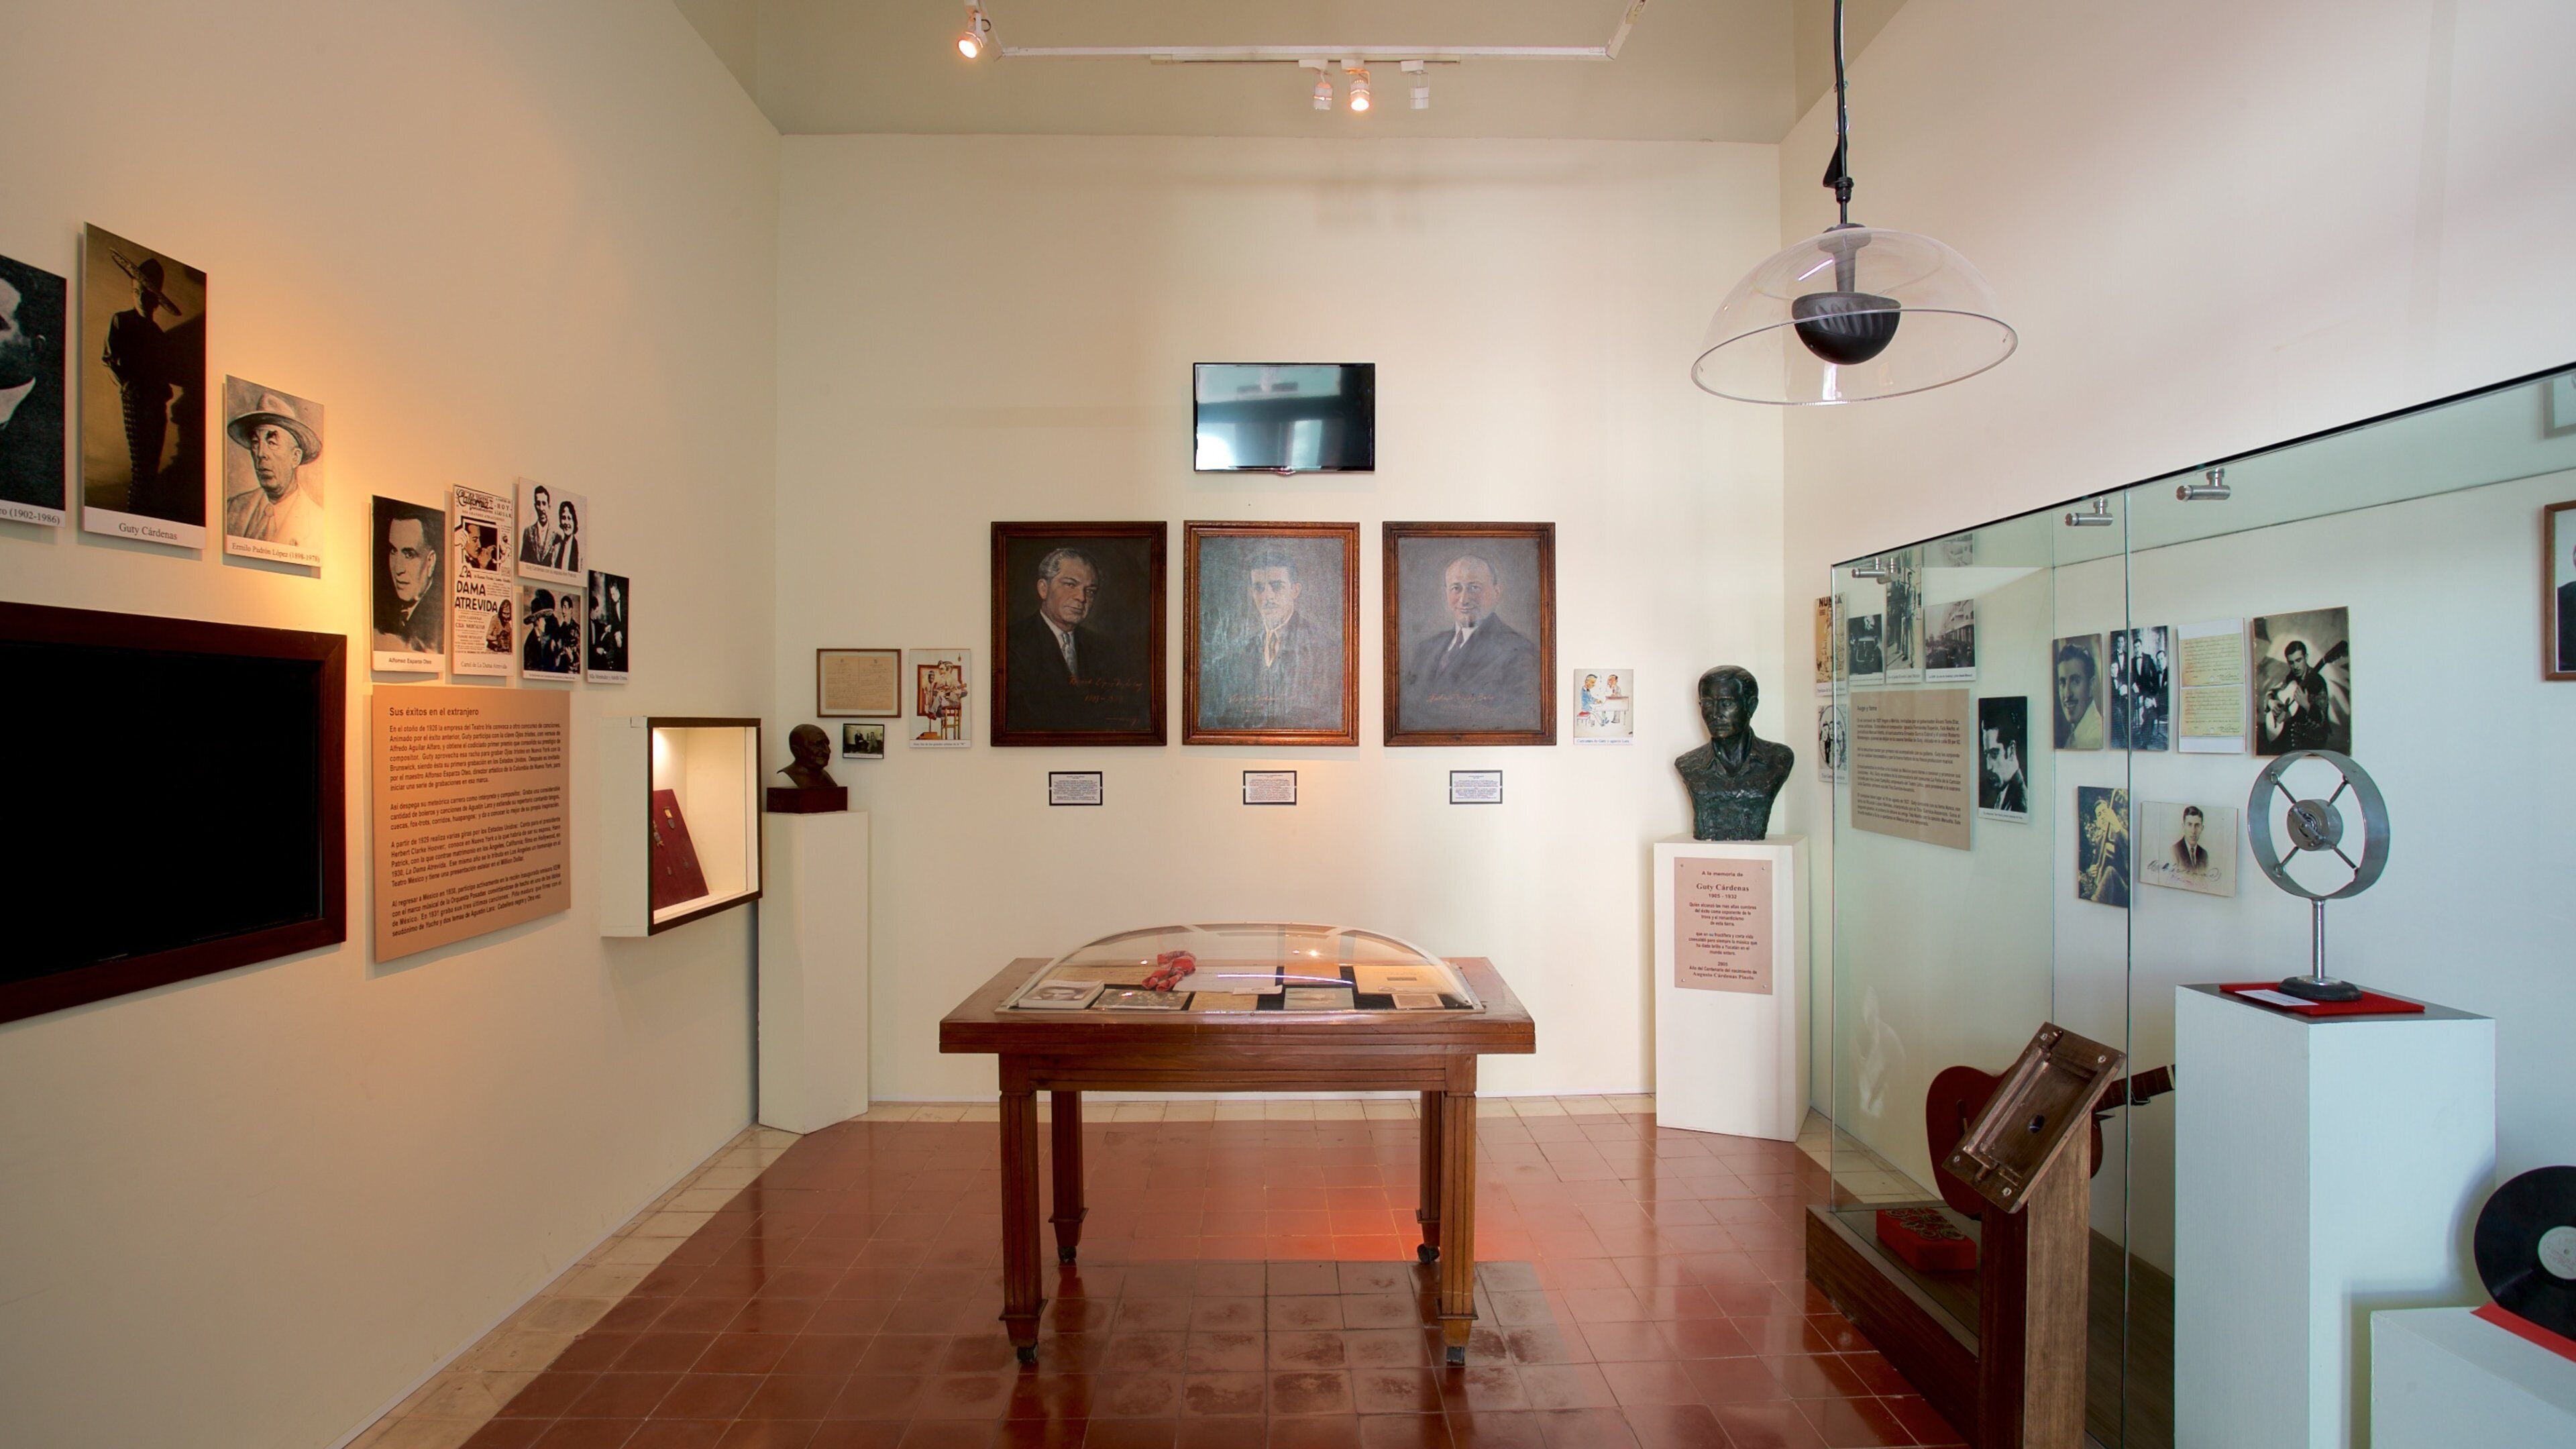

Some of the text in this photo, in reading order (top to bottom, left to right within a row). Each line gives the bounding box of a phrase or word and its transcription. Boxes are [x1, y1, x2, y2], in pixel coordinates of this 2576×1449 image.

[10, 508, 60, 525] (1902-1986)
[119, 523, 178, 540] Guty Cárdenas
[232, 543, 252, 552] Ermilo
[252, 545, 271, 555] Padrón
[272, 549, 288, 558] López
[456, 580, 486, 596] DAMA
[455, 597, 498, 612] ATREVIDA
[389, 707, 404, 716] Sus
[405, 707, 427, 716] éxitos
[439, 707, 445, 715] el
[447, 707, 478, 717] extranjero
[1697, 883, 1714, 892] Guty
